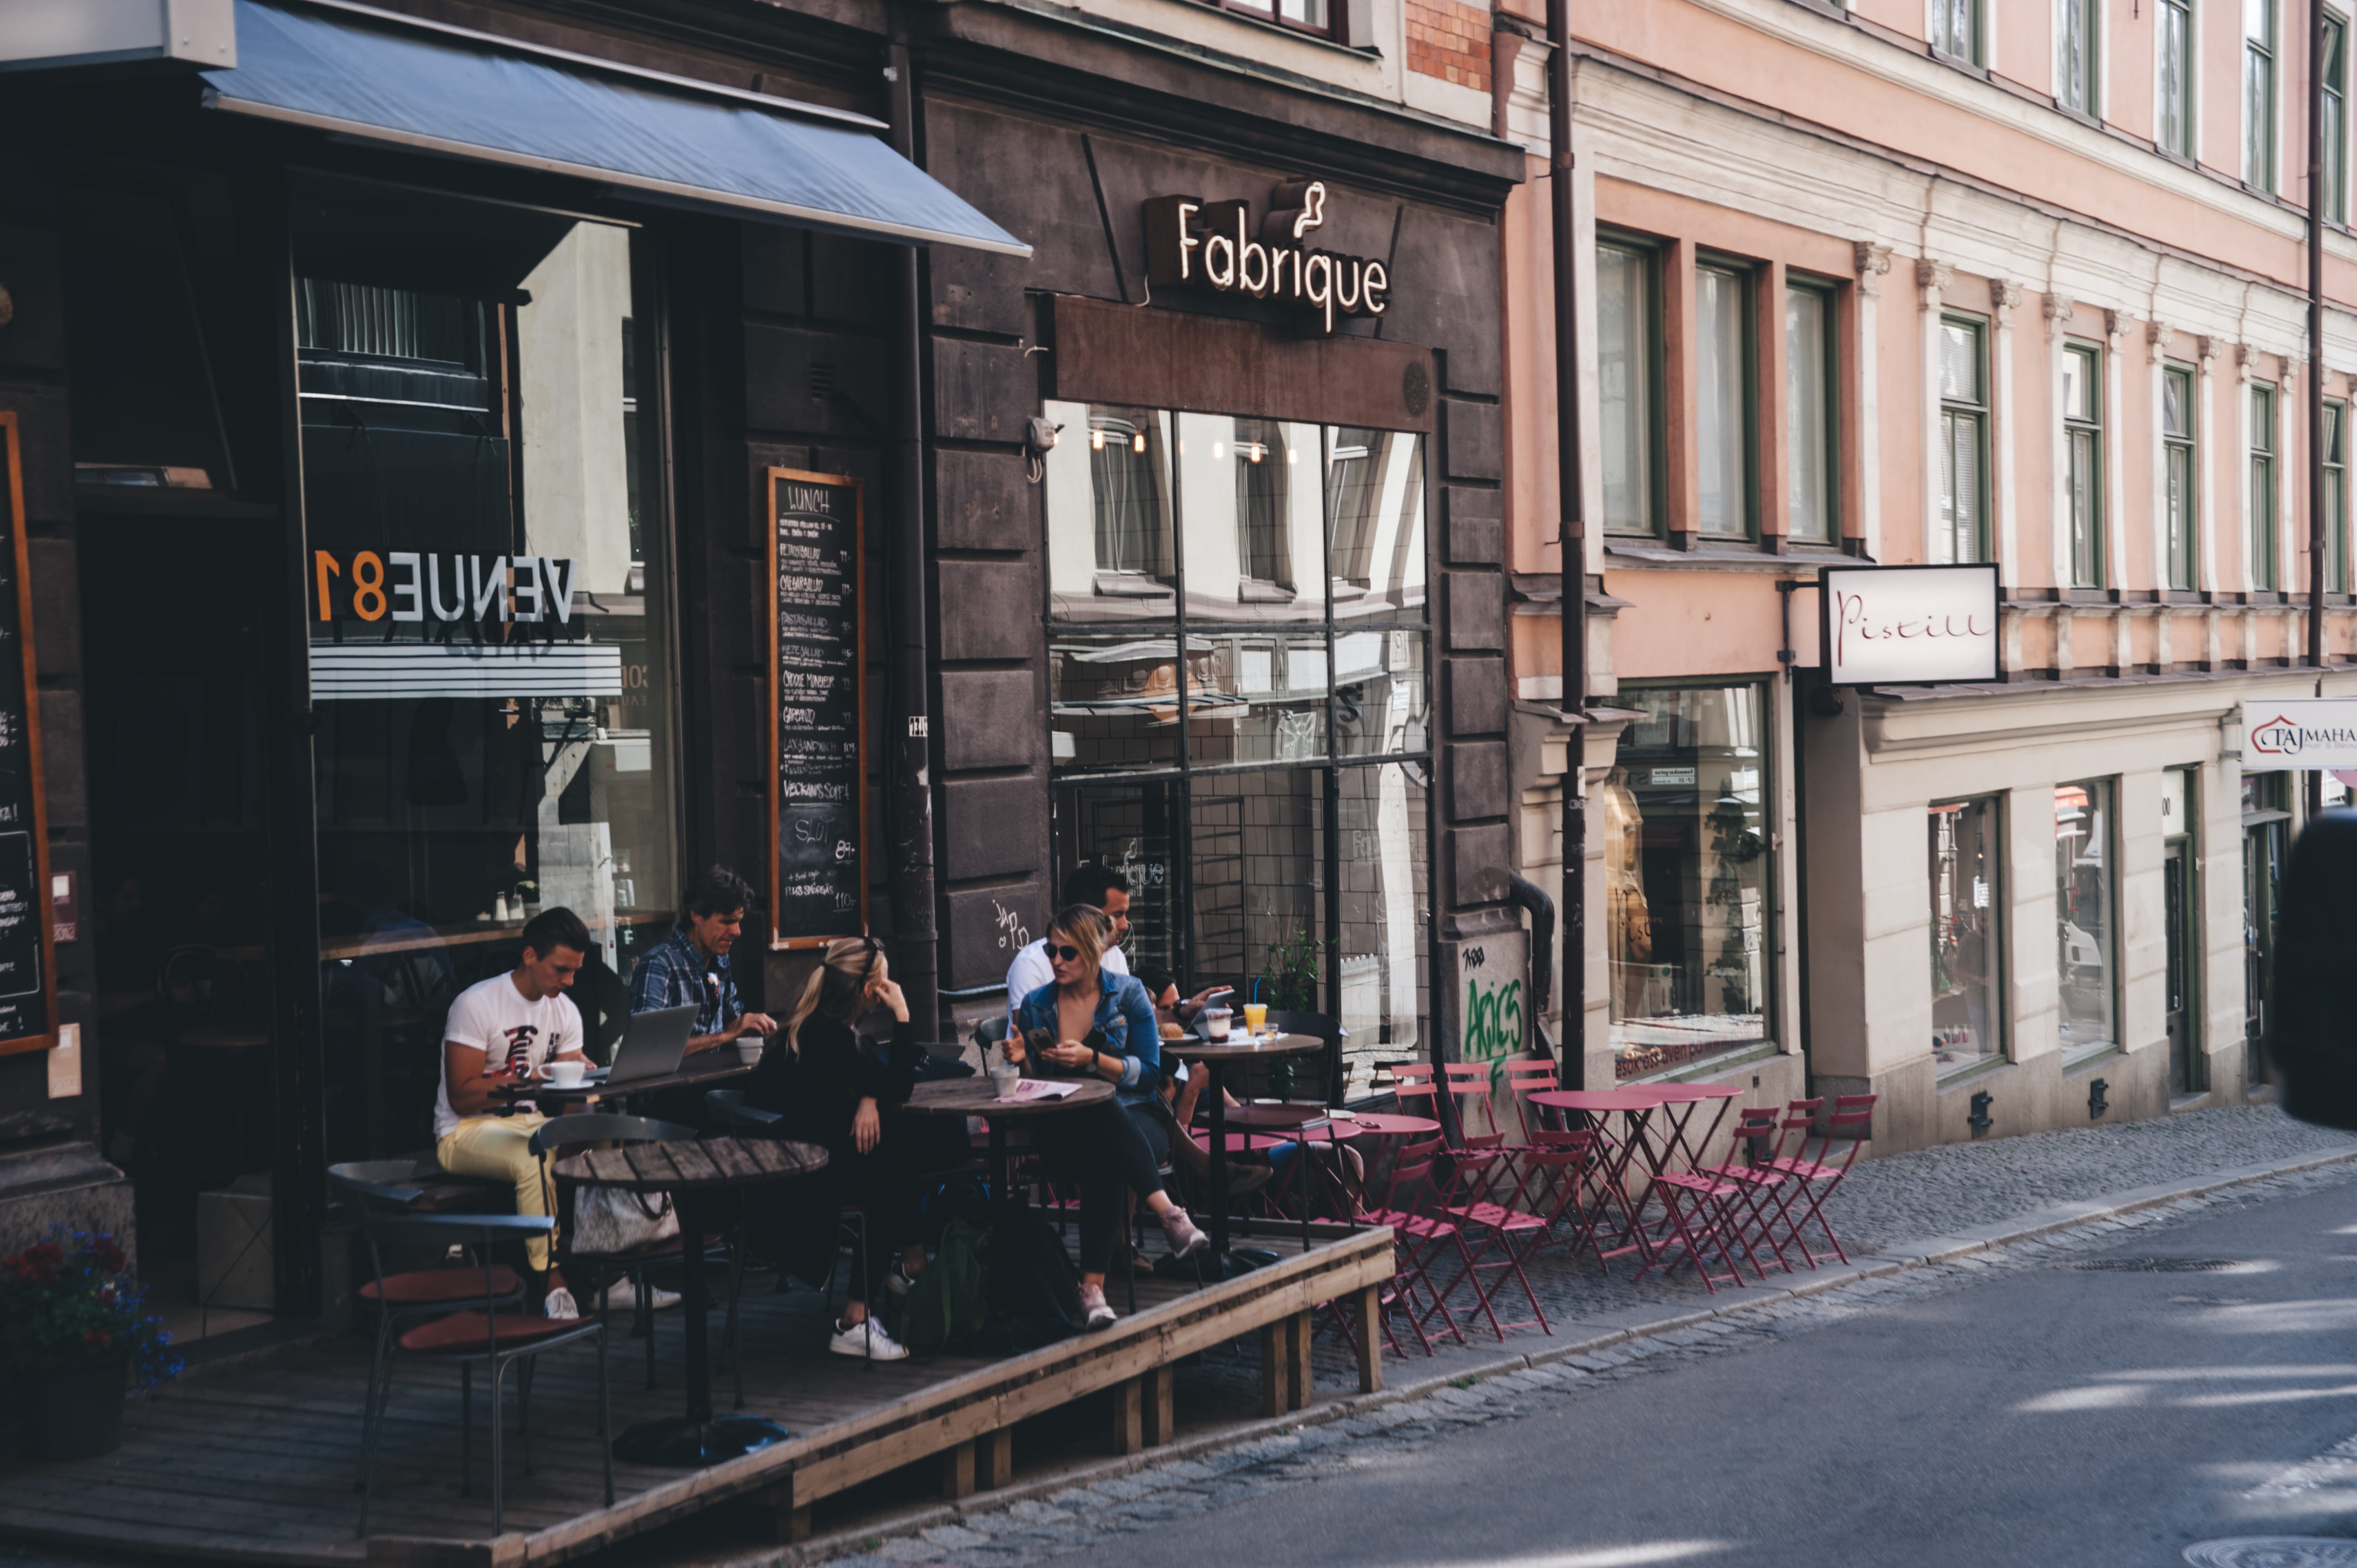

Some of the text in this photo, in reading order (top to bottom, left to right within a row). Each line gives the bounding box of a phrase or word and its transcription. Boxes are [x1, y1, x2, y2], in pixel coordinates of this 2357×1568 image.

[1179, 203, 1387, 333] Fabrique
[788, 485, 831, 513] LUNCH
[781, 611, 828, 628] PASTASALLAD
[1837, 590, 1993, 667] Pistill
[2261, 728, 2357, 755] TAJ MAHA
[784, 779, 824, 799] VECKANS
